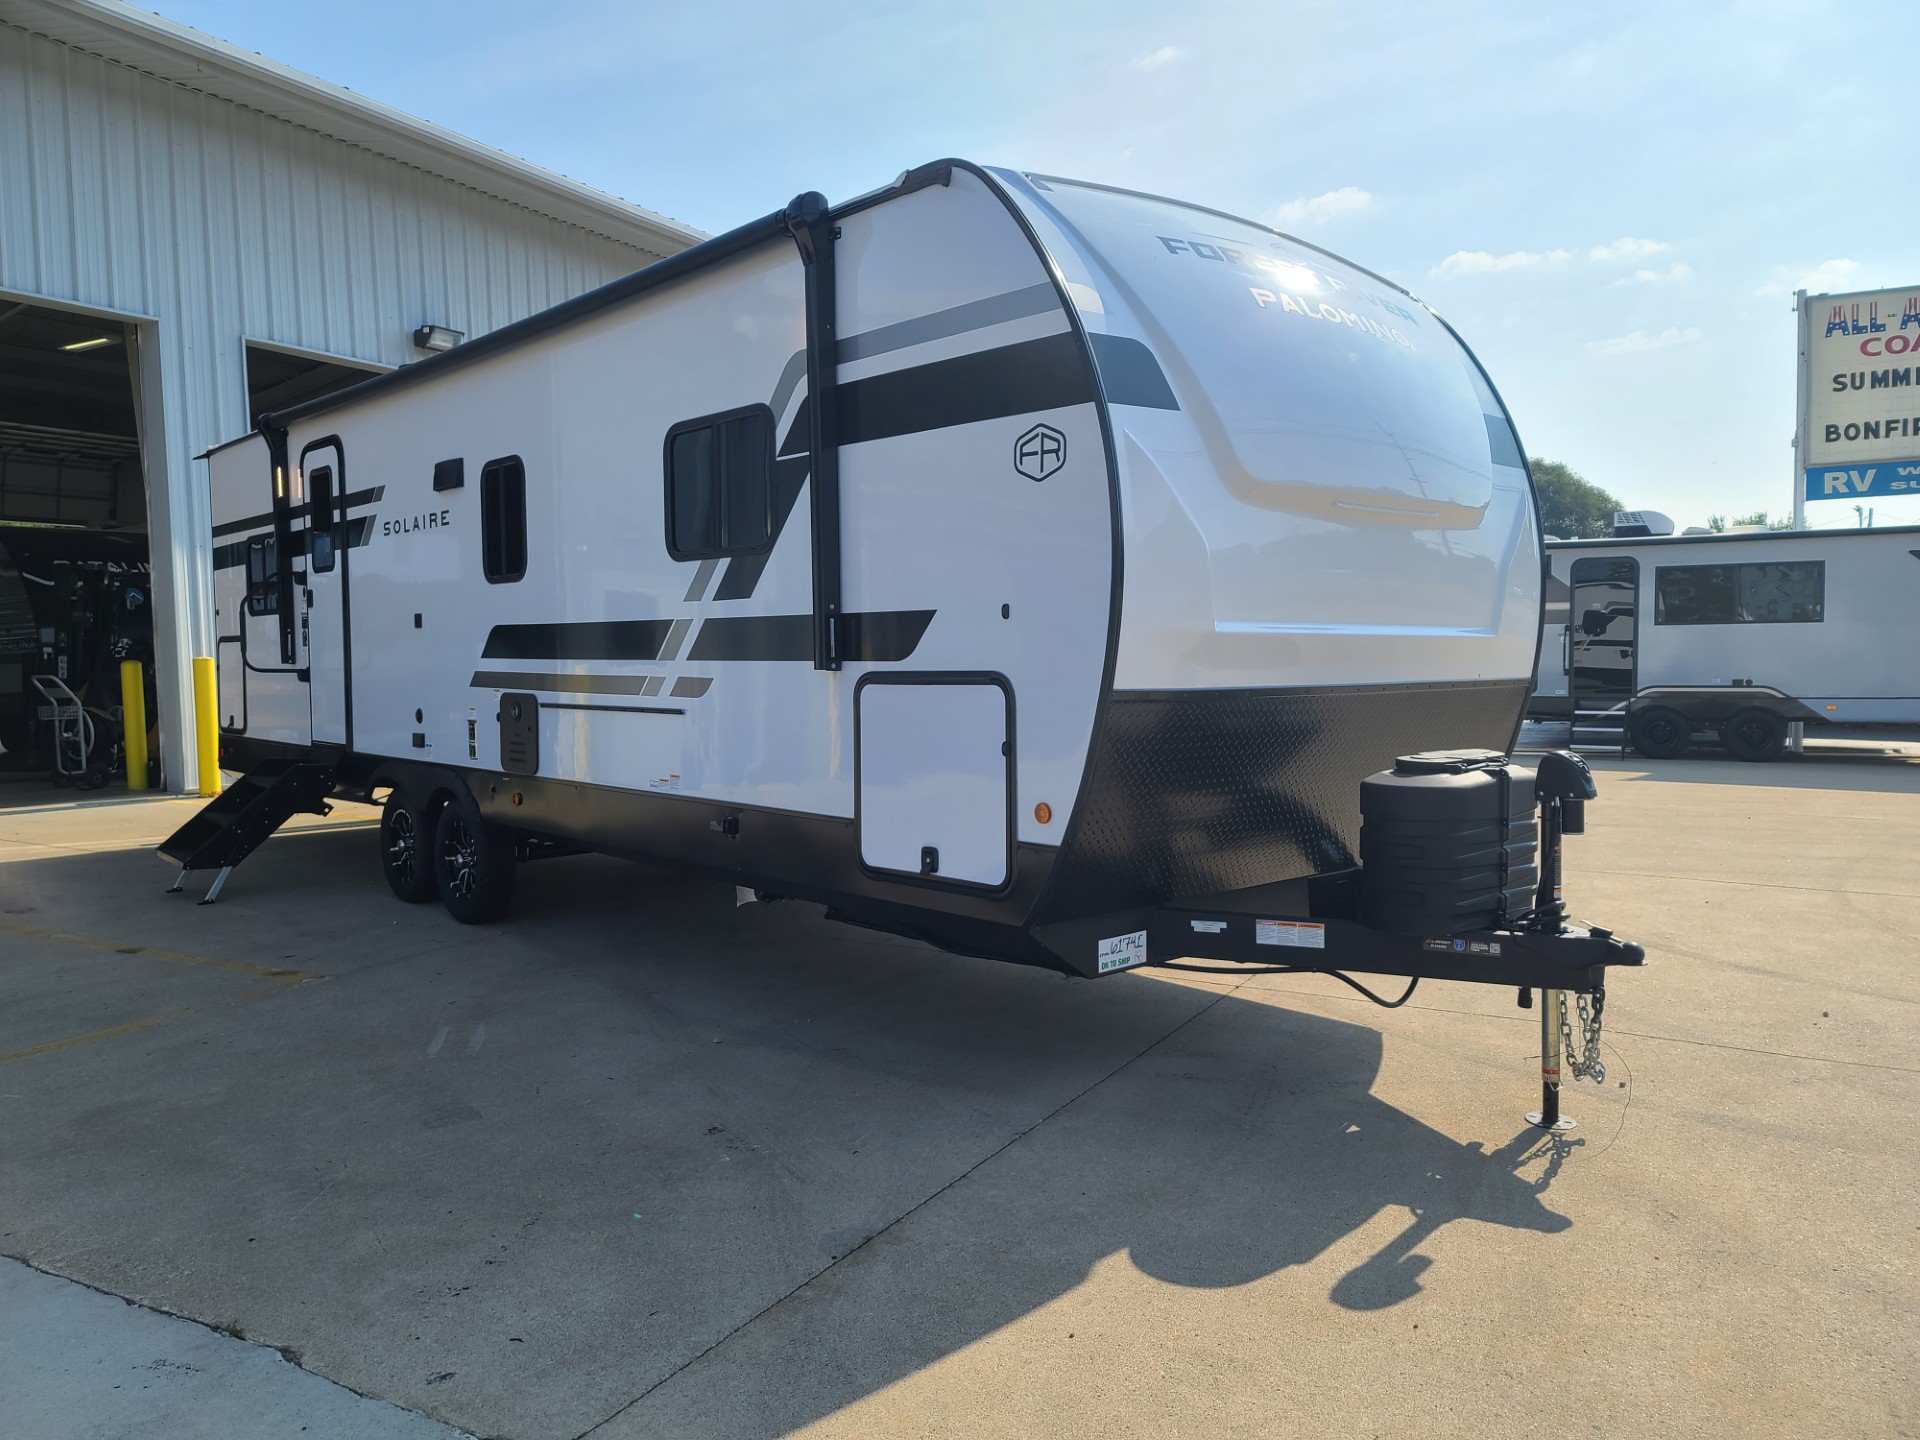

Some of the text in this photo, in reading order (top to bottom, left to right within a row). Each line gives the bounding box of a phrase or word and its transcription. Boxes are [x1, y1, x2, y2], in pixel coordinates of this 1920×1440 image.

[1249, 286, 1413, 349] PALOMINO
[1832, 367, 1920, 392] SUMM
[1019, 431, 1061, 474] FR
[1823, 469, 1877, 495] RV
[383, 509, 450, 537] SOLAIRE
[1101, 956, 1131, 970] OK TO SHIP
